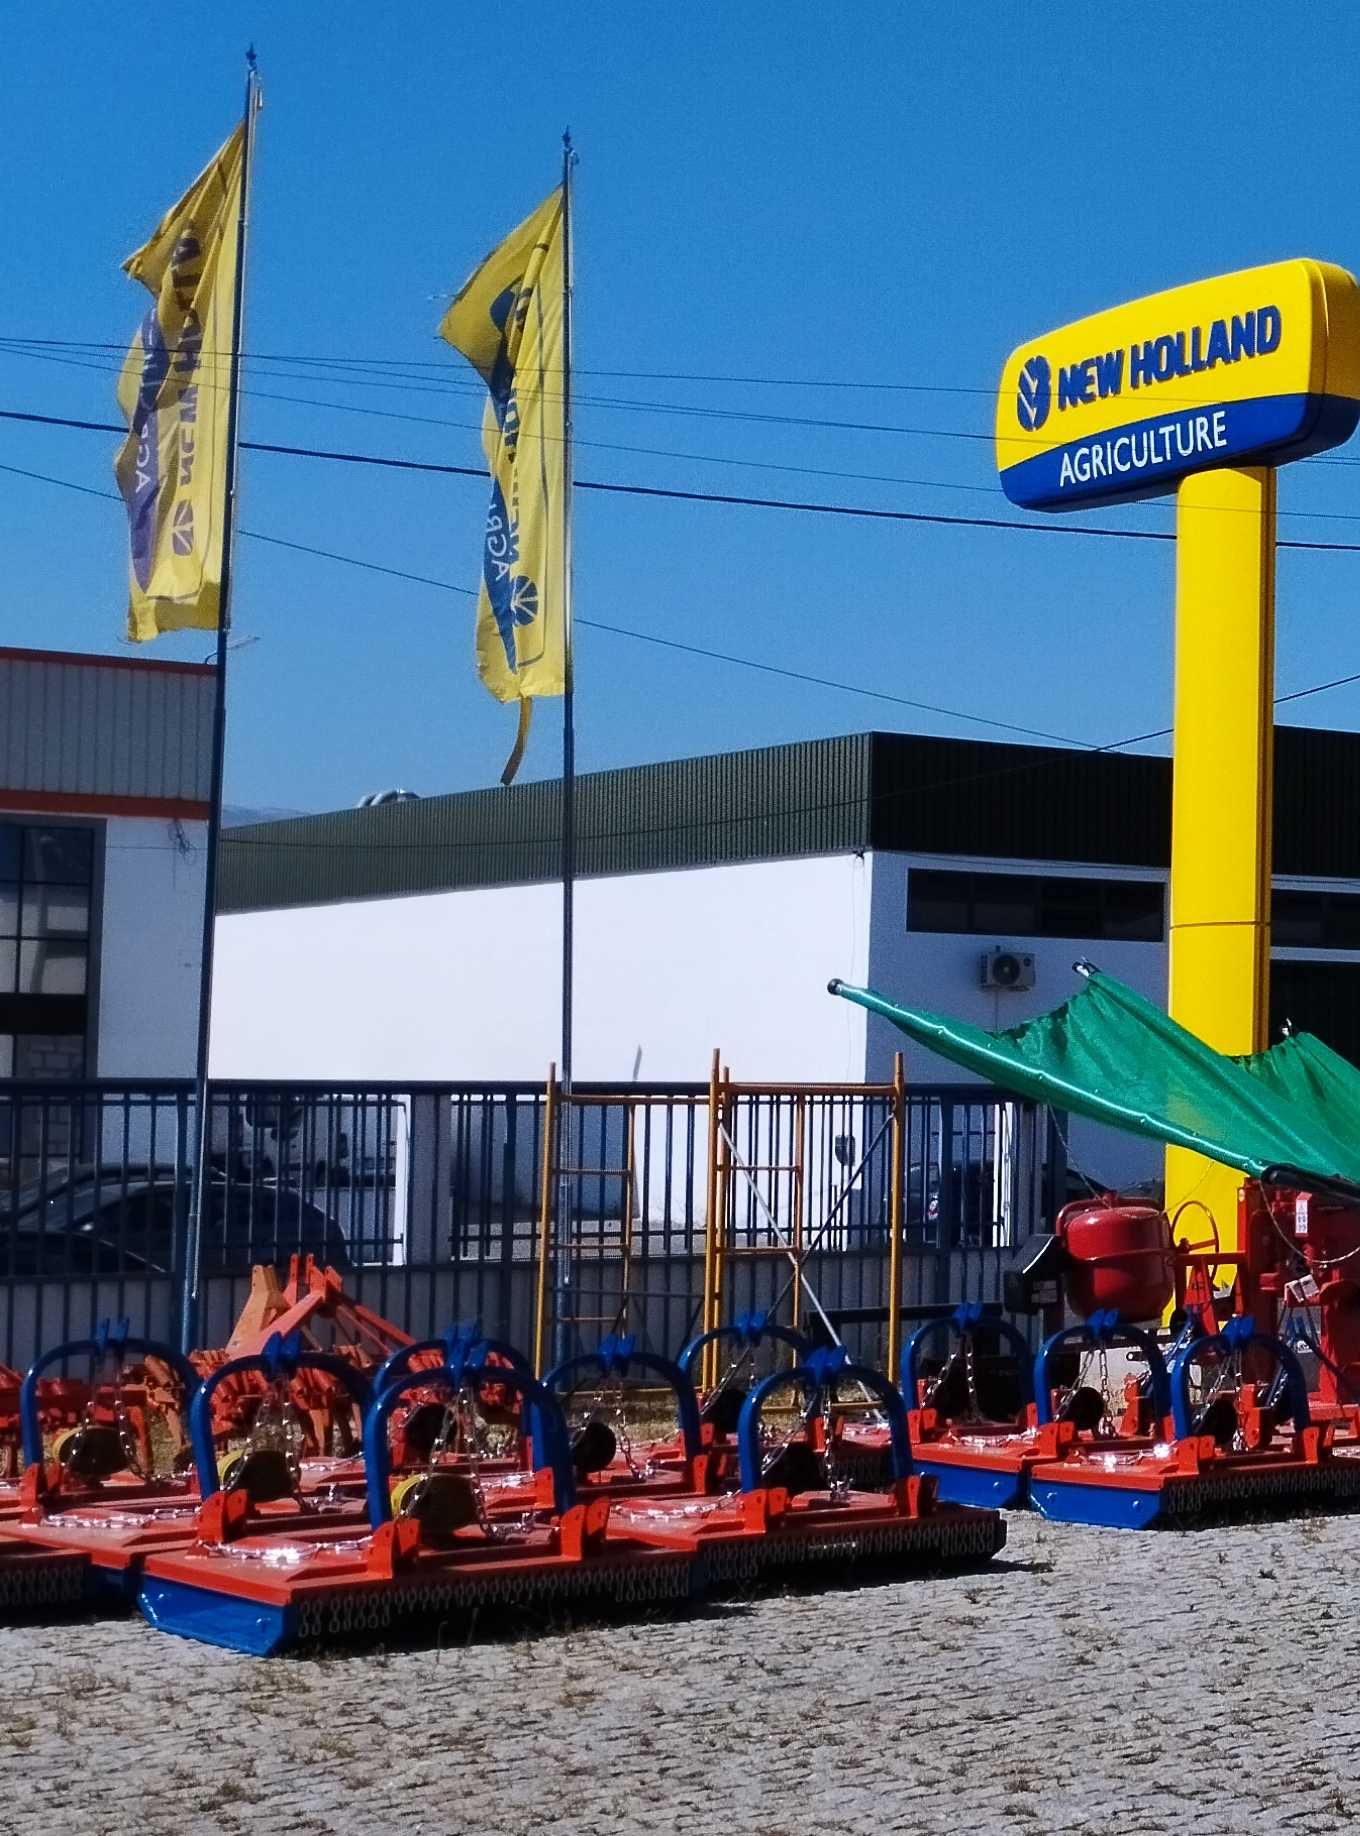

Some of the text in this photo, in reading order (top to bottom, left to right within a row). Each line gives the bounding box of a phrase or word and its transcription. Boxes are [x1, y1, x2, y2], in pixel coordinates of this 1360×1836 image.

[1057, 304, 1282, 411] NEW HOLLAND
[1059, 410, 1228, 487] AGRICULTURE
